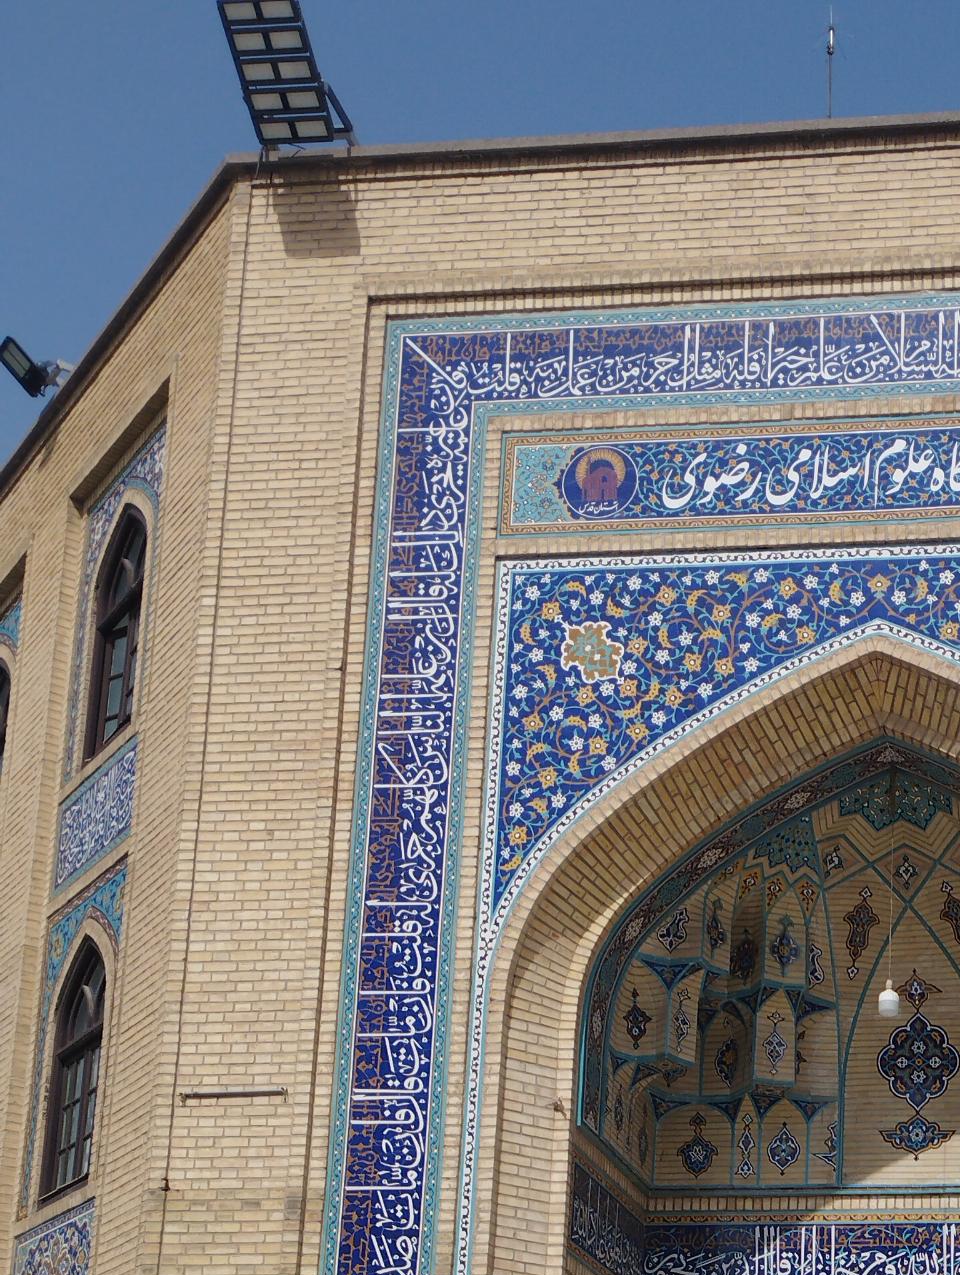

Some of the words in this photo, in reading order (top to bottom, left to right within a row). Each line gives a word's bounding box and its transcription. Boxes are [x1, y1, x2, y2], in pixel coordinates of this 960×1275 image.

[662, 444, 762, 508] رضوی
[766, 446, 871, 506] اسلامی
[875, 439, 935, 509] علوم
